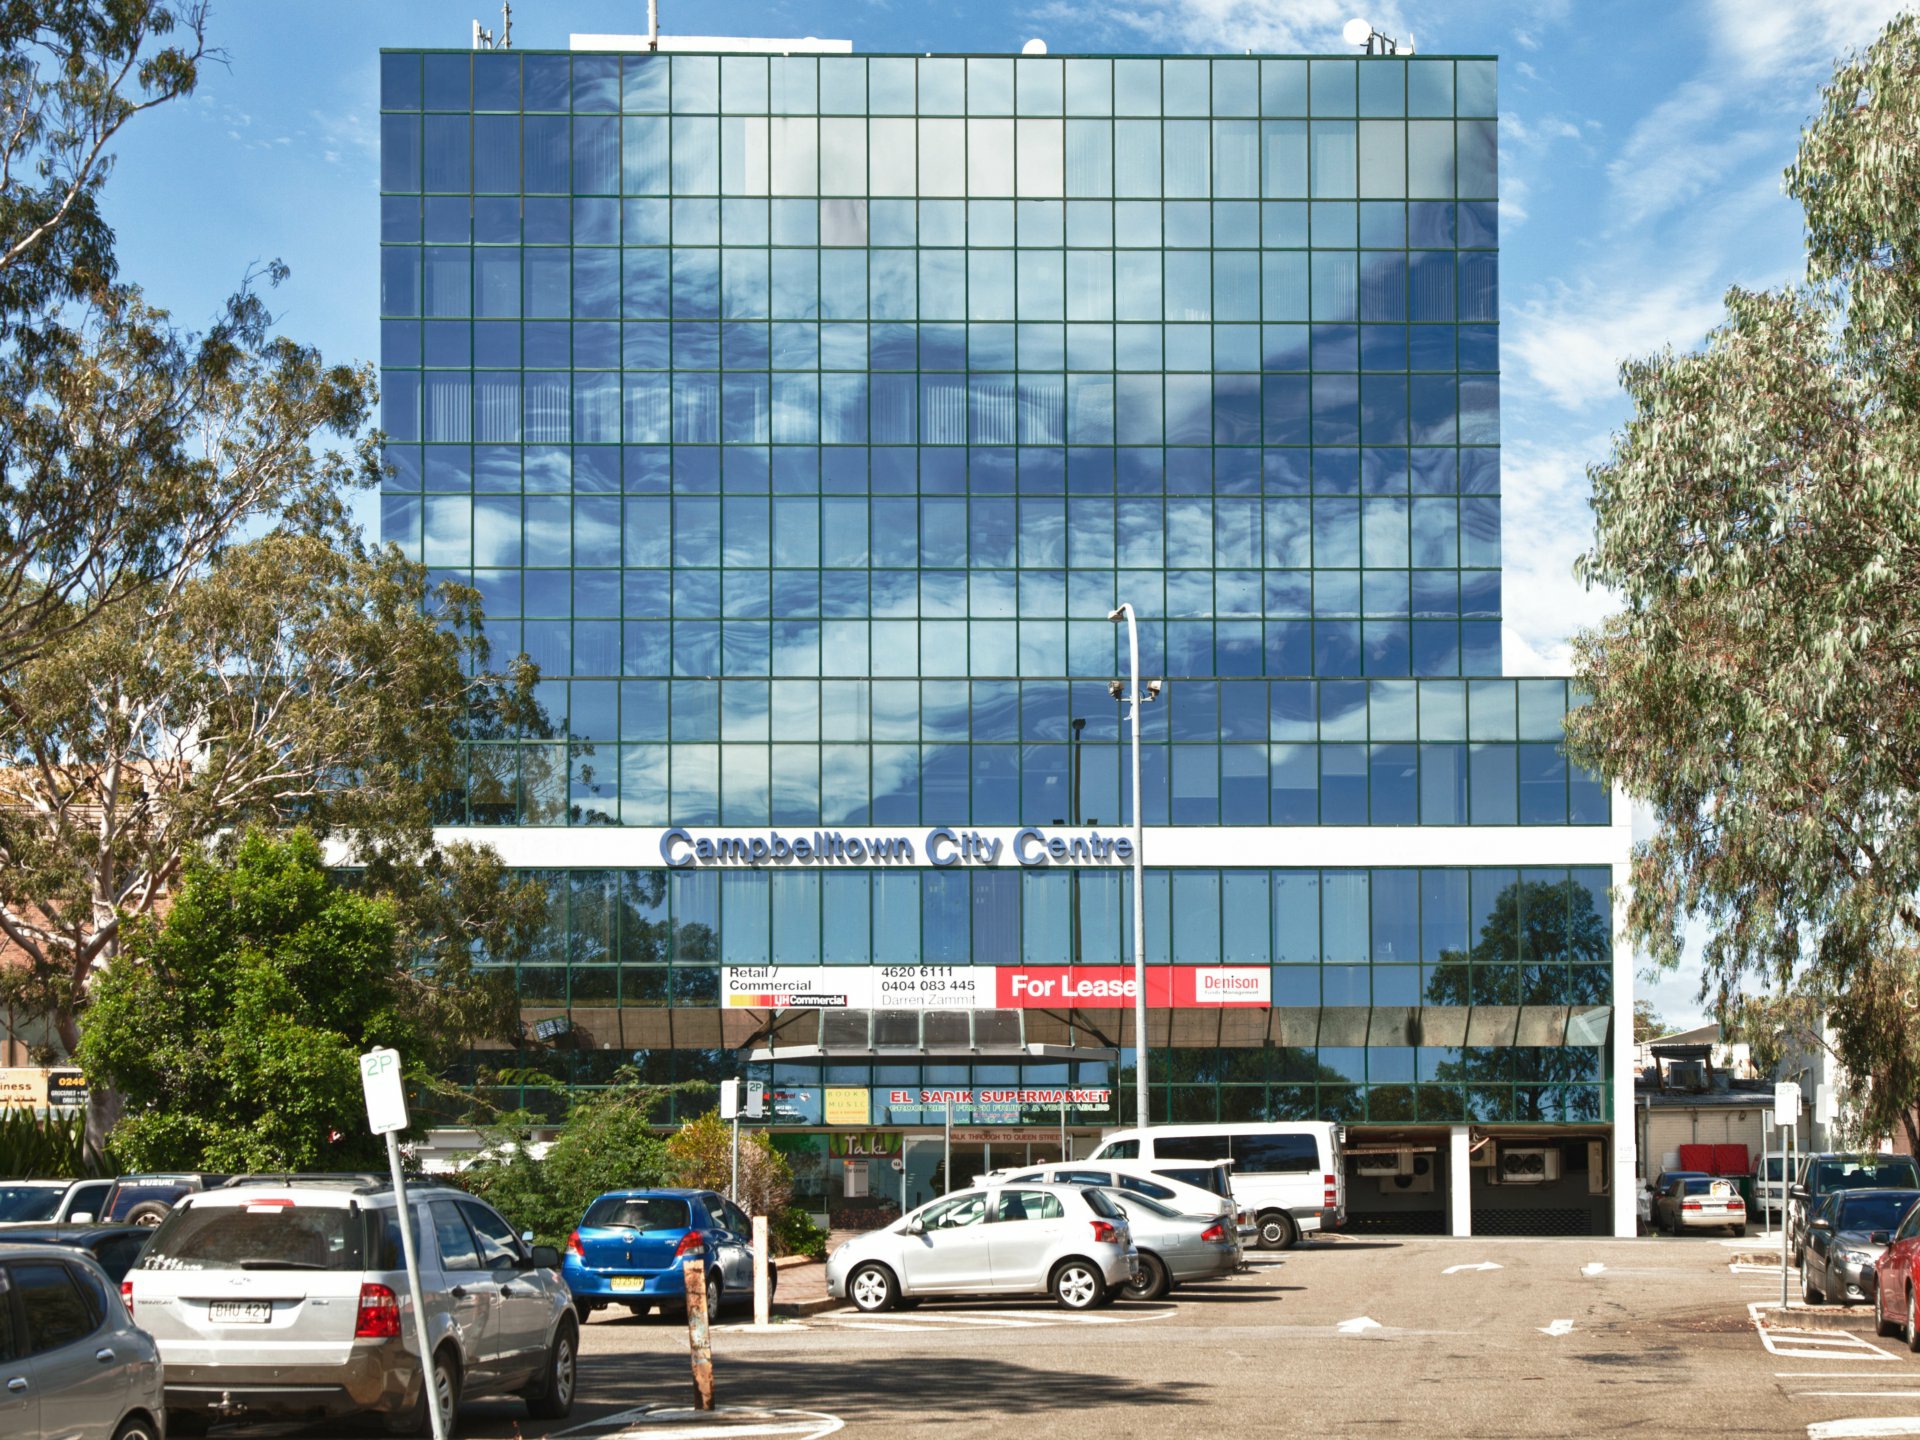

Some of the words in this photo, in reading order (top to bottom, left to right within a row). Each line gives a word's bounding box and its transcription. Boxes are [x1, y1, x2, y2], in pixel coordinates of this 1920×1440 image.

[659, 827, 911, 865] Campbelltown
[925, 827, 1001, 865] City
[1013, 827, 1133, 865] Centre
[729, 967, 768, 978] Retail
[881, 966, 916, 977] 4620
[920, 966, 953, 977] 6111
[729, 980, 812, 991] Commercial
[881, 981, 916, 991] 0404
[920, 980, 946, 991] 083
[949, 980, 976, 991] 445
[1011, 974, 1056, 997] For
[1061, 974, 1137, 997] Lease
[1204, 975, 1259, 989] Denison
[881, 994, 925, 1006] Darren
[928, 993, 976, 1005] Zammit
[366, 1055, 393, 1077] 2P
[749, 1082, 763, 1092] 2P
[889, 1090, 914, 1103] EL
[920, 1090, 974, 1103] SADIK
[980, 1089, 1112, 1103] SUPERMARKET
[1002, 1133, 1012, 1141] TO
